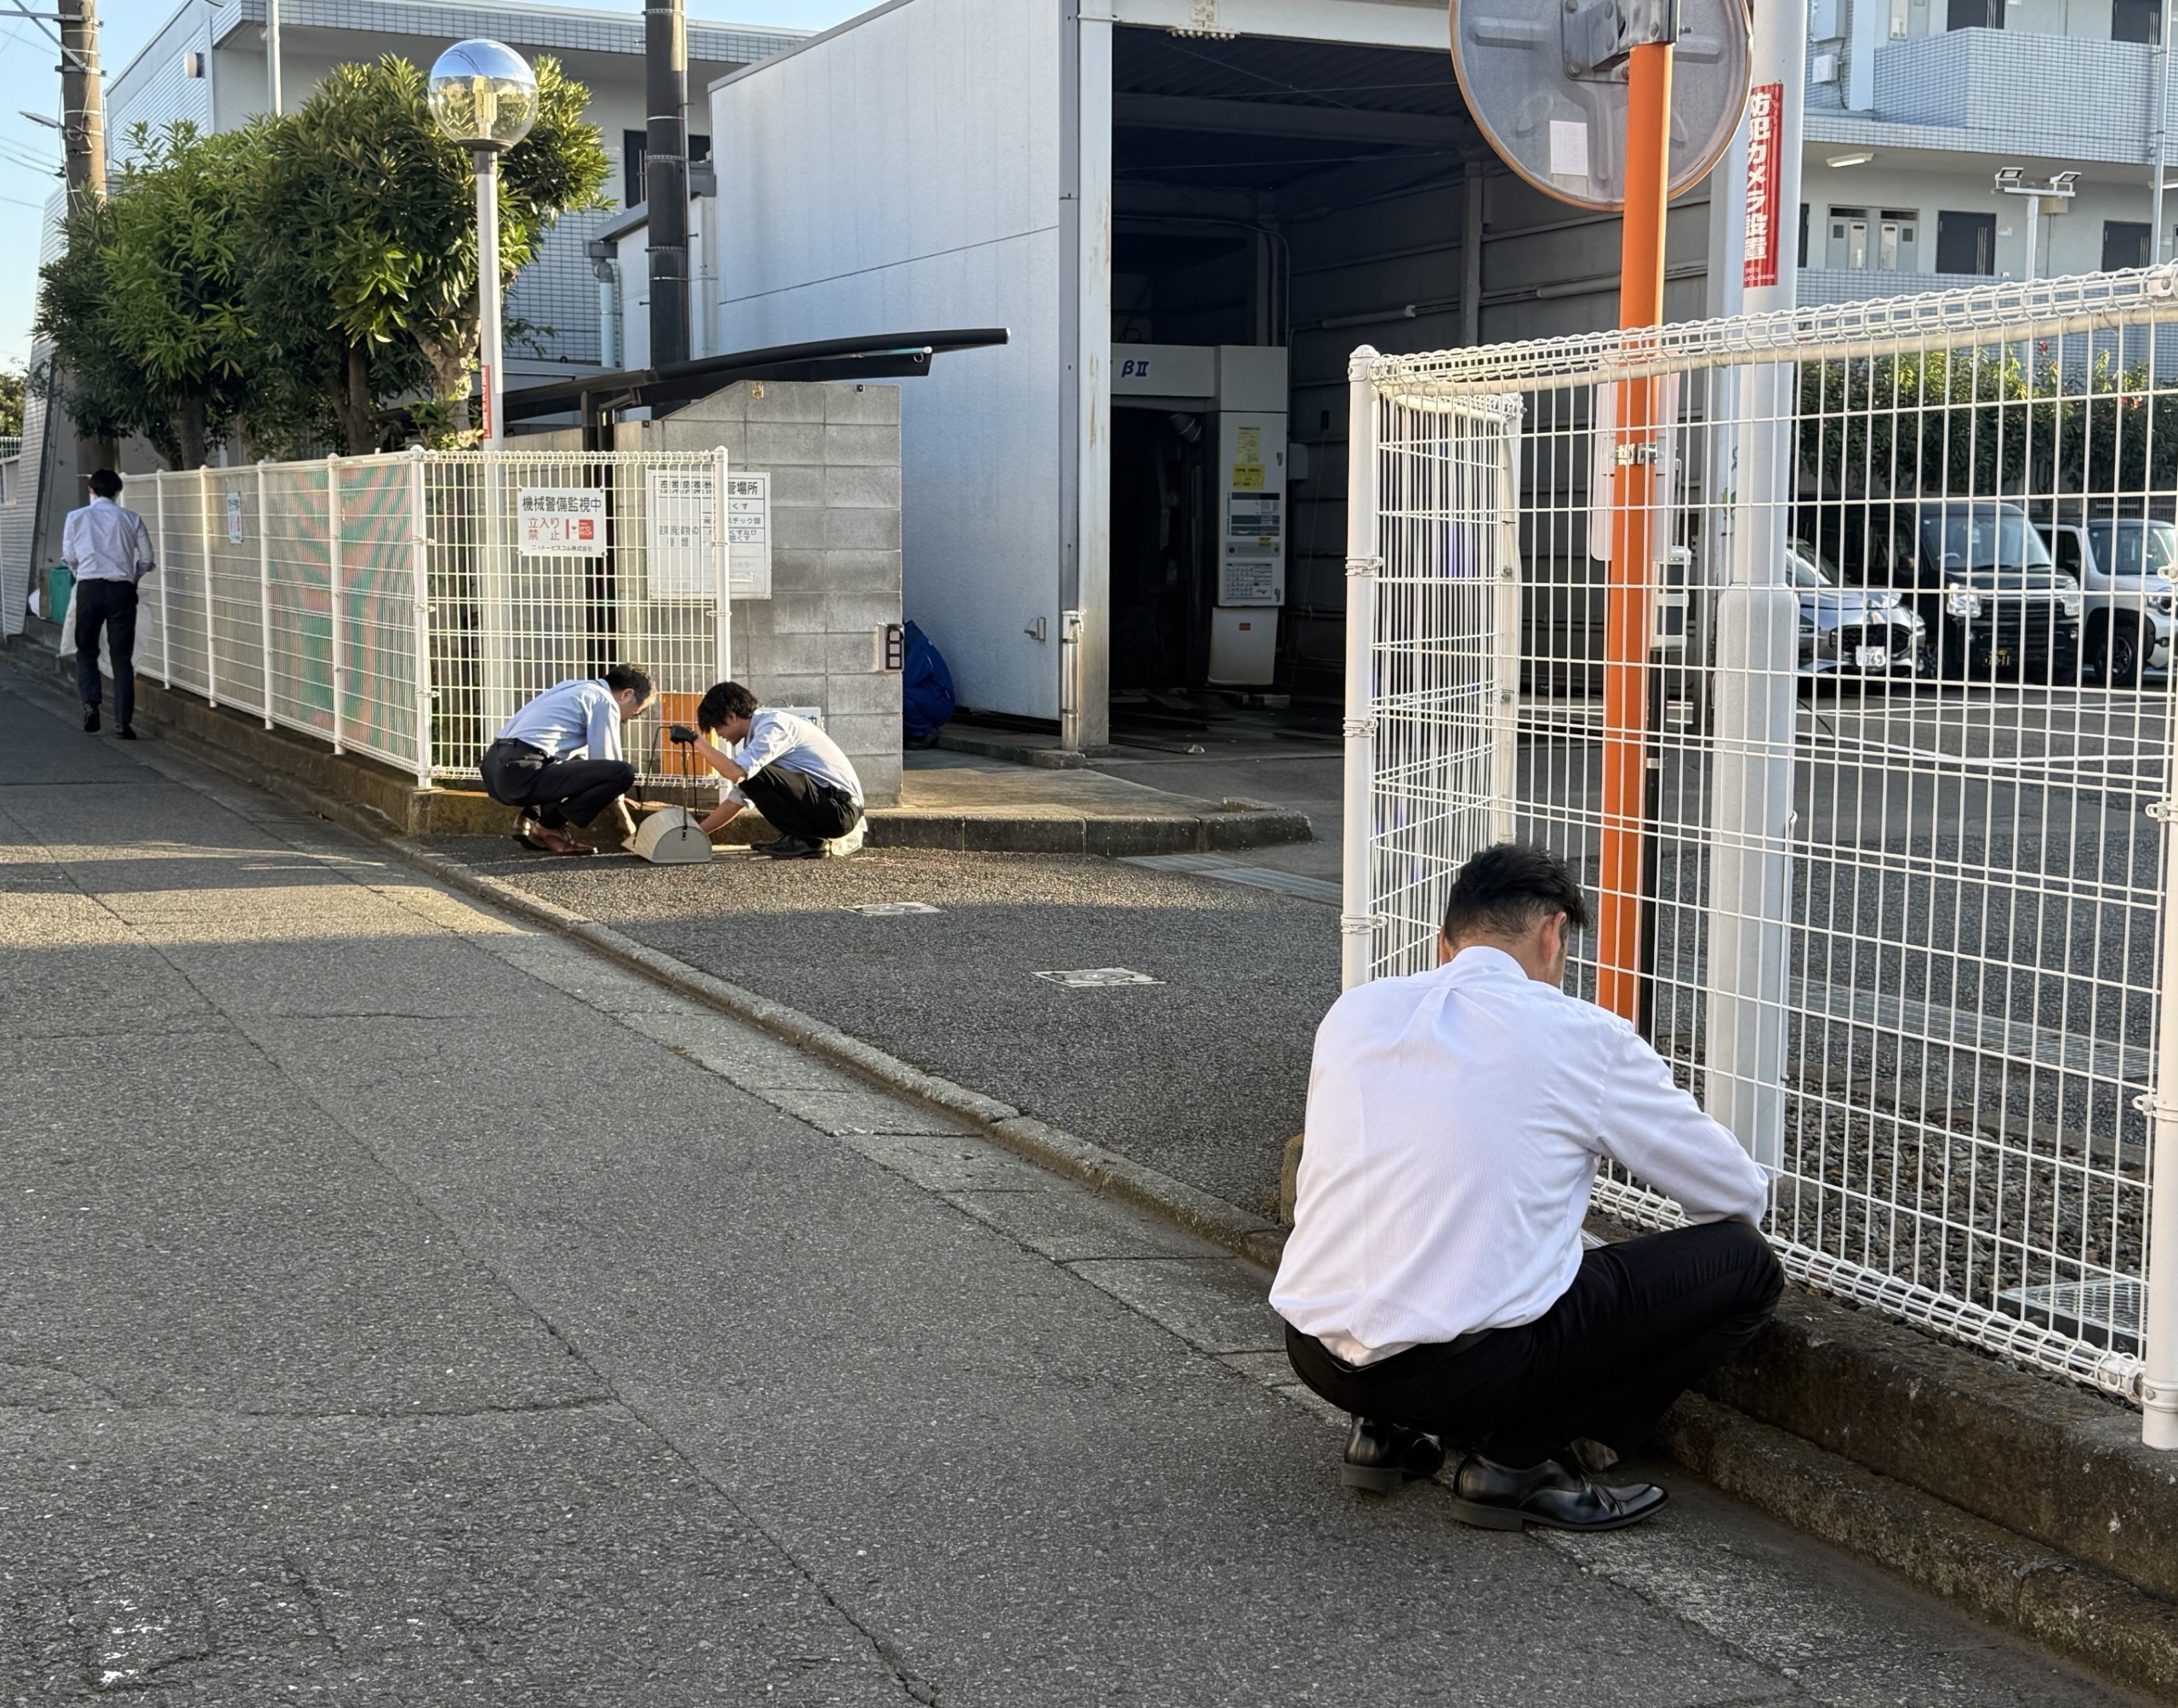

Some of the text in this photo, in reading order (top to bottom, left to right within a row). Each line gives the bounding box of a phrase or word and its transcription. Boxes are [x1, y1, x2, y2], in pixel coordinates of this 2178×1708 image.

[1744, 92, 1771, 262] 防犯カメラ設置
[660, 480, 758, 495] 産業廃棄物管場所
[522, 496, 602, 512] 機械警備監視中
[527, 516, 560, 529] 立入り
[703, 516, 761, 525] 廃チック類
[527, 529, 560, 540] 禁止
